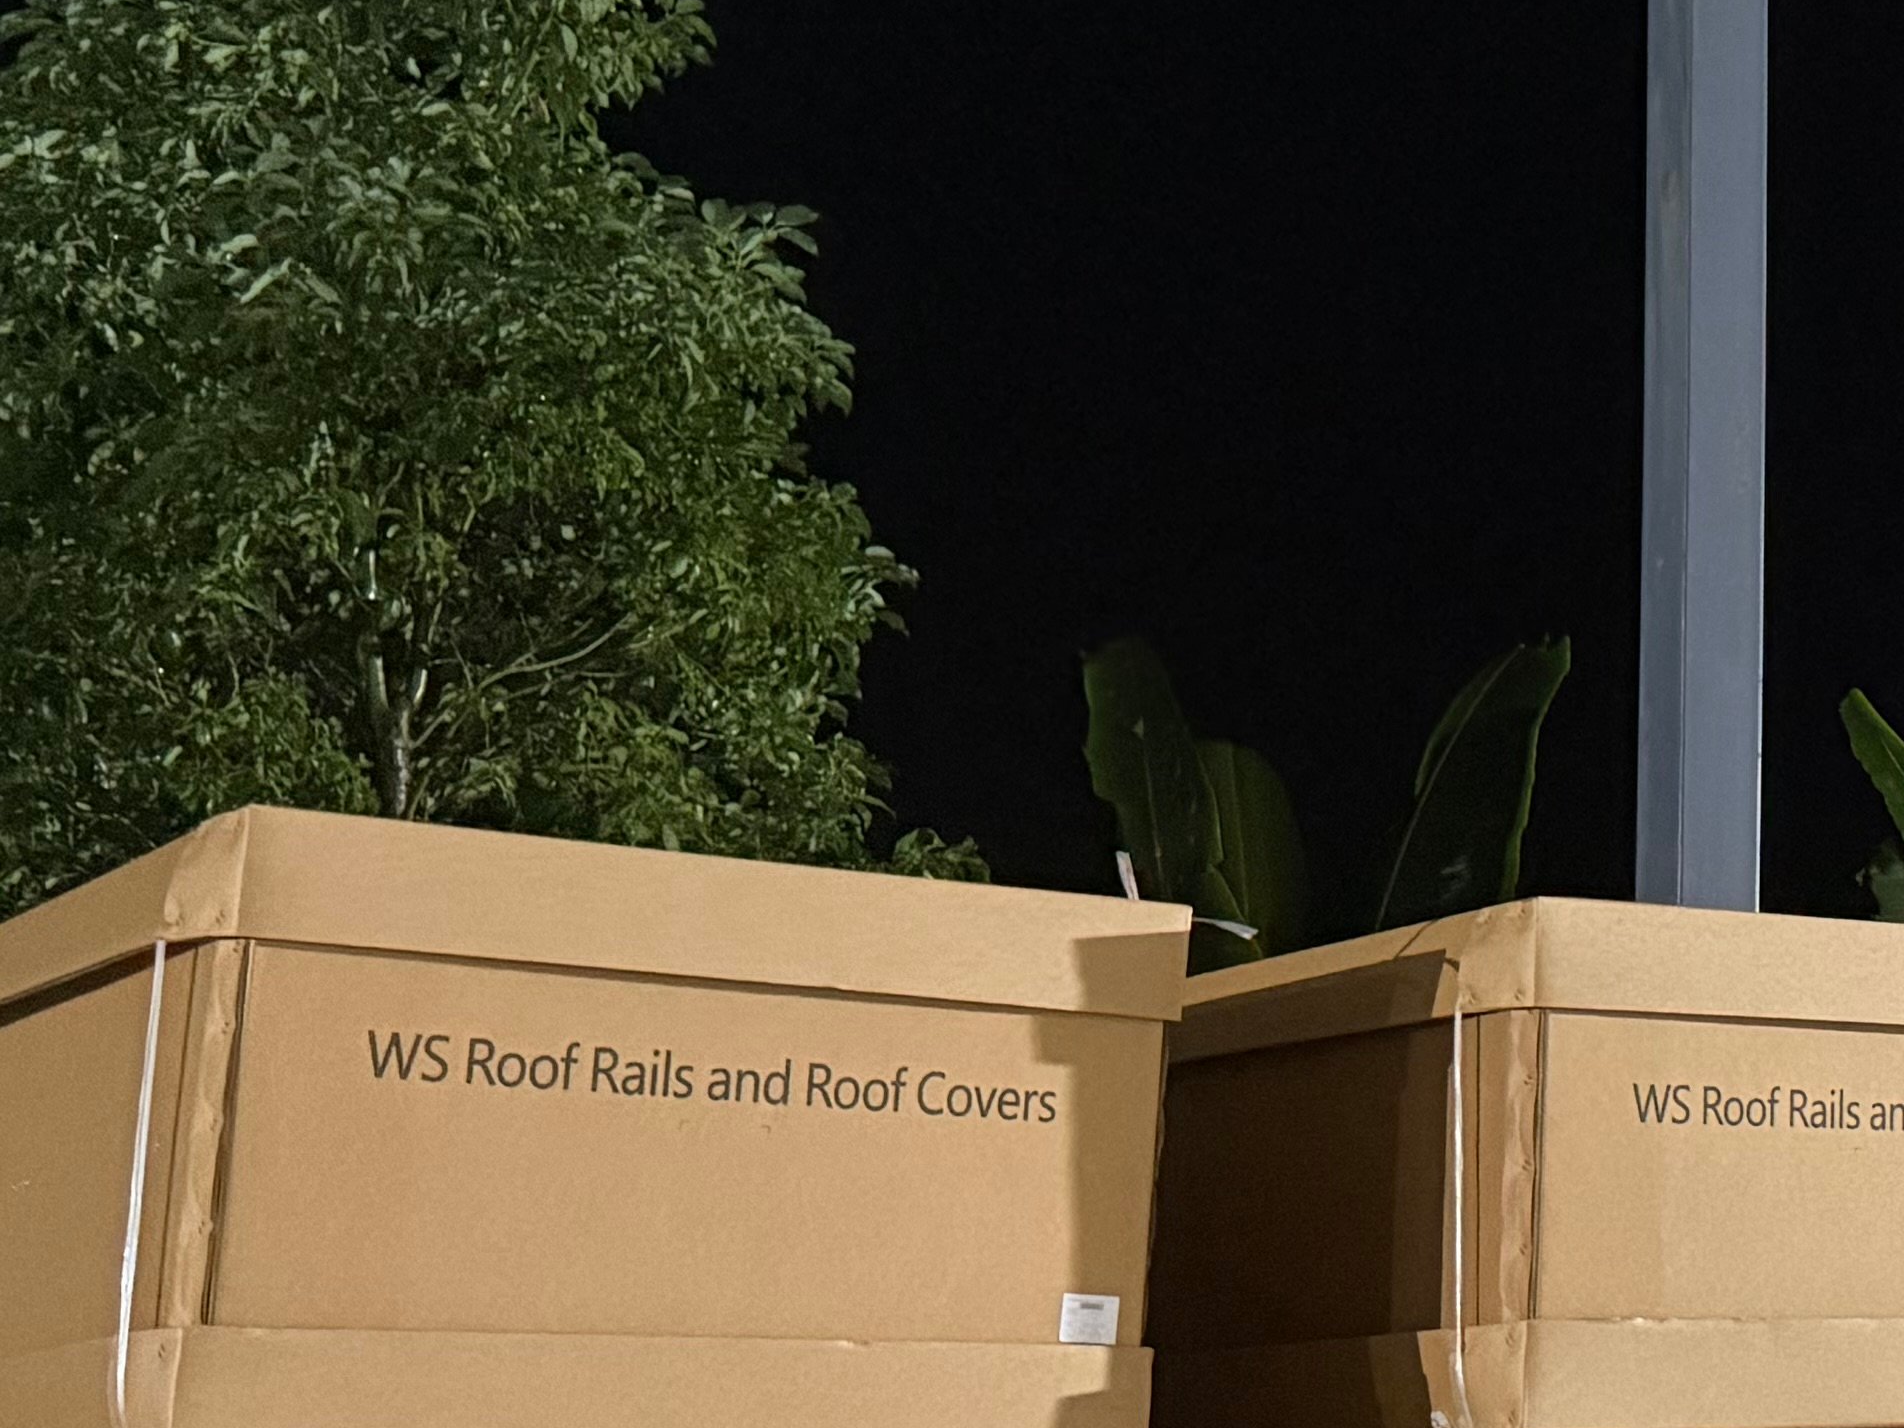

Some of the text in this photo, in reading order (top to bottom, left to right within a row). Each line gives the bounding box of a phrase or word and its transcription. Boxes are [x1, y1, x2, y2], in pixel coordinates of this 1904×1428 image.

[368, 1030, 1056, 1123] WS Roof Rails and Roof Covers
[1633, 1083, 1690, 1124] WS
[1703, 1086, 1780, 1127] Roof
[1790, 1089, 1860, 1130] Rails
